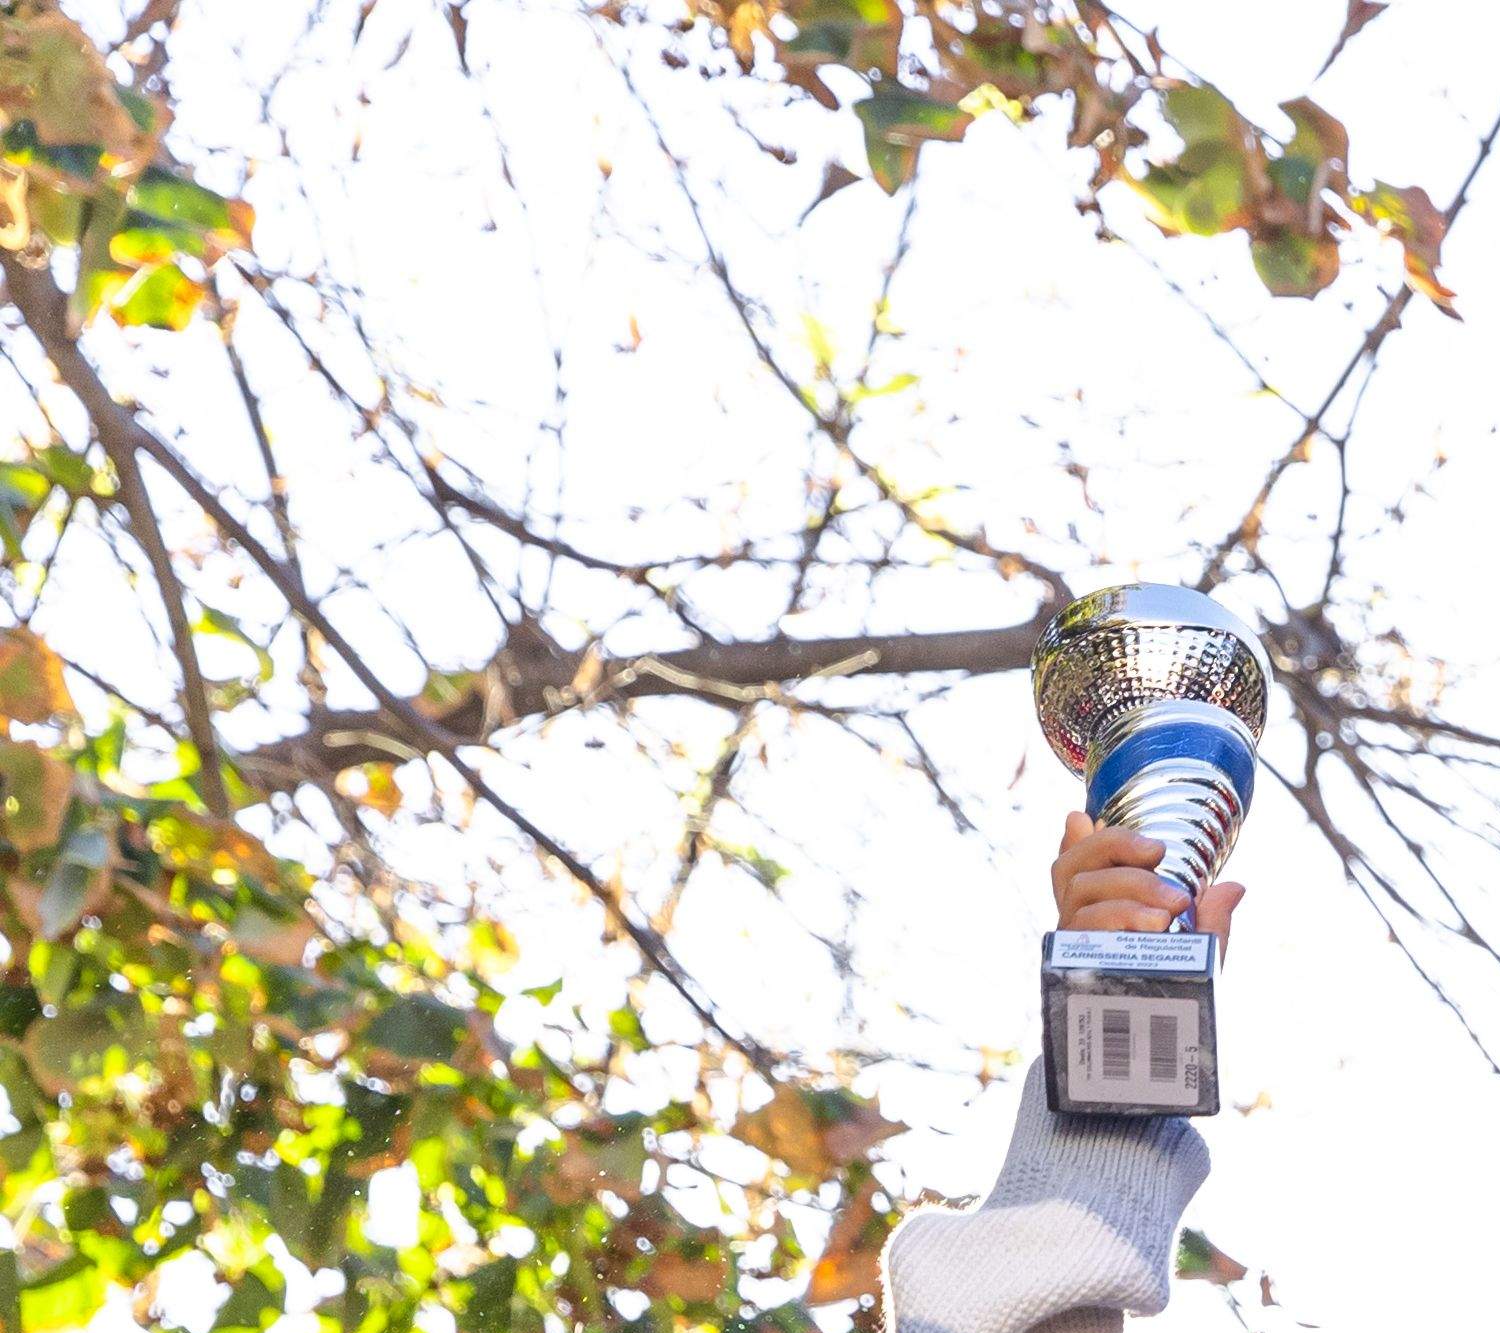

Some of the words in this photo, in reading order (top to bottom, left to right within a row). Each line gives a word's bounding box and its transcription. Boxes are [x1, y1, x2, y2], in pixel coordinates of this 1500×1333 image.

[1139, 944, 1192, 952] Regularitat
[1062, 951, 1138, 960] CARNISSERIA
[1140, 953, 1196, 962] SEGARRA
